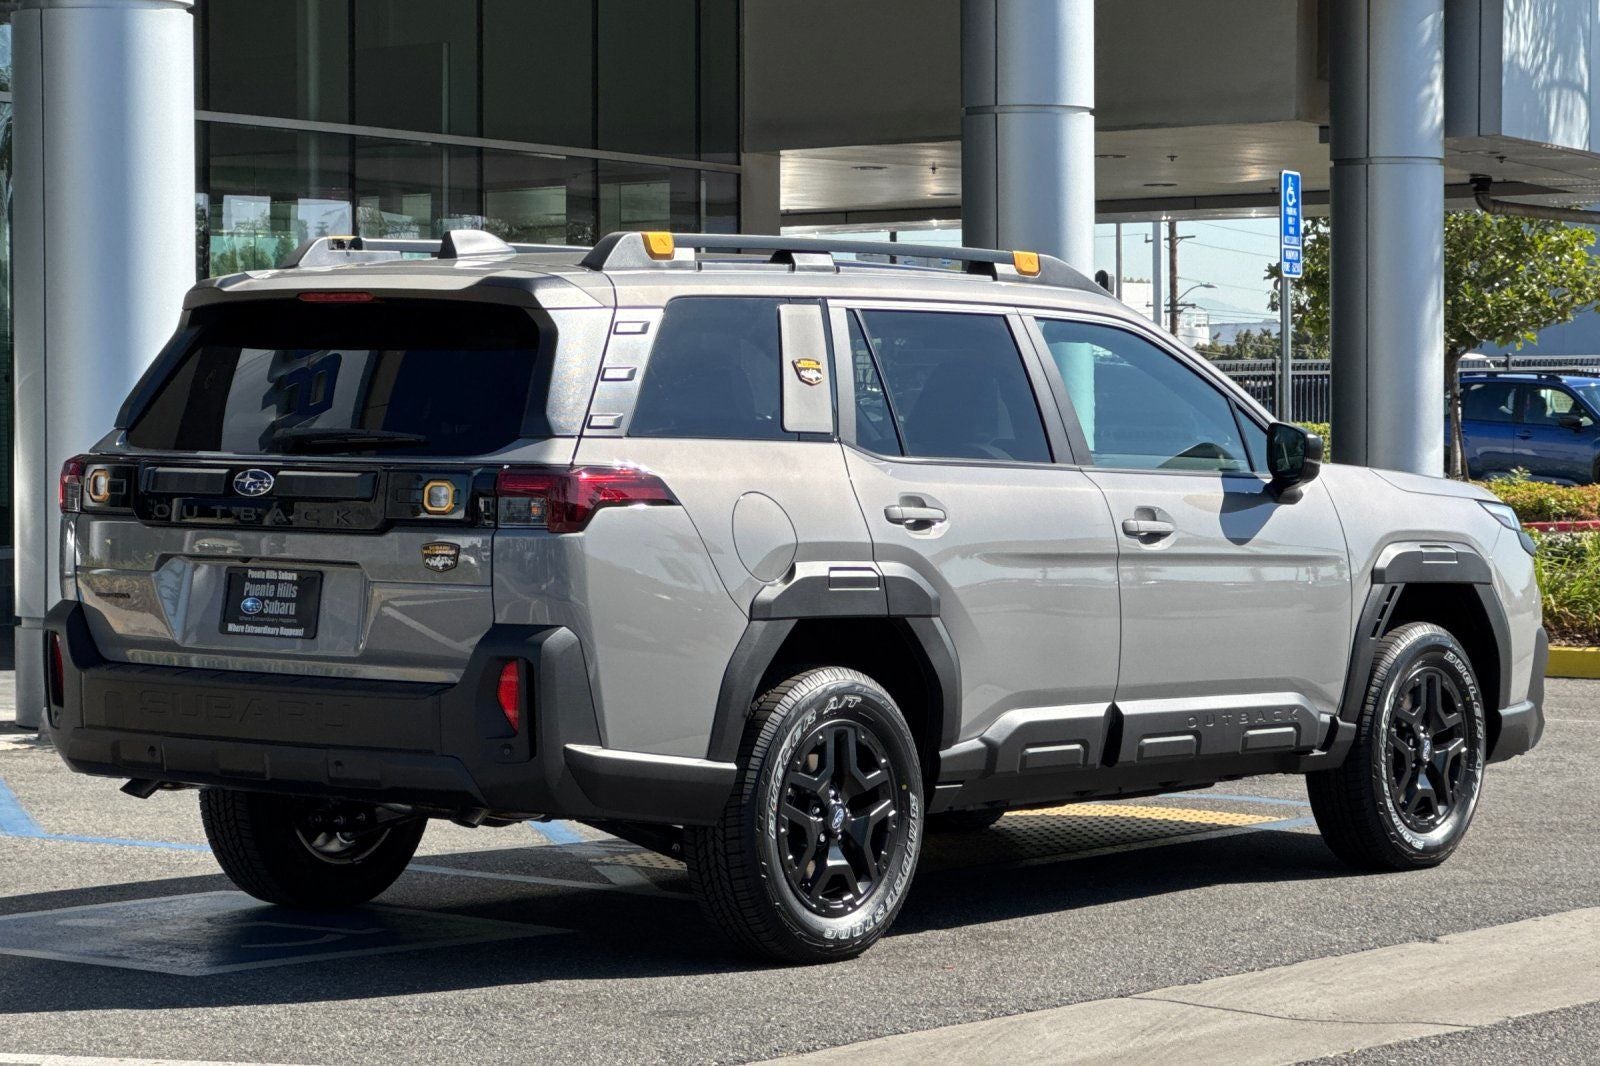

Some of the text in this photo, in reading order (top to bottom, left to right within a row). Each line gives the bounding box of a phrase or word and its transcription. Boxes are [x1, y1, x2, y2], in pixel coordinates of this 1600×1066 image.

[152, 503, 351, 526] OUTBACK
[243, 582, 298, 598] Puente Hills
[263, 600, 296, 615] Subaru
[1186, 707, 1299, 729] OUTBACK
[822, 791, 920, 940] BRIDGESTONE
